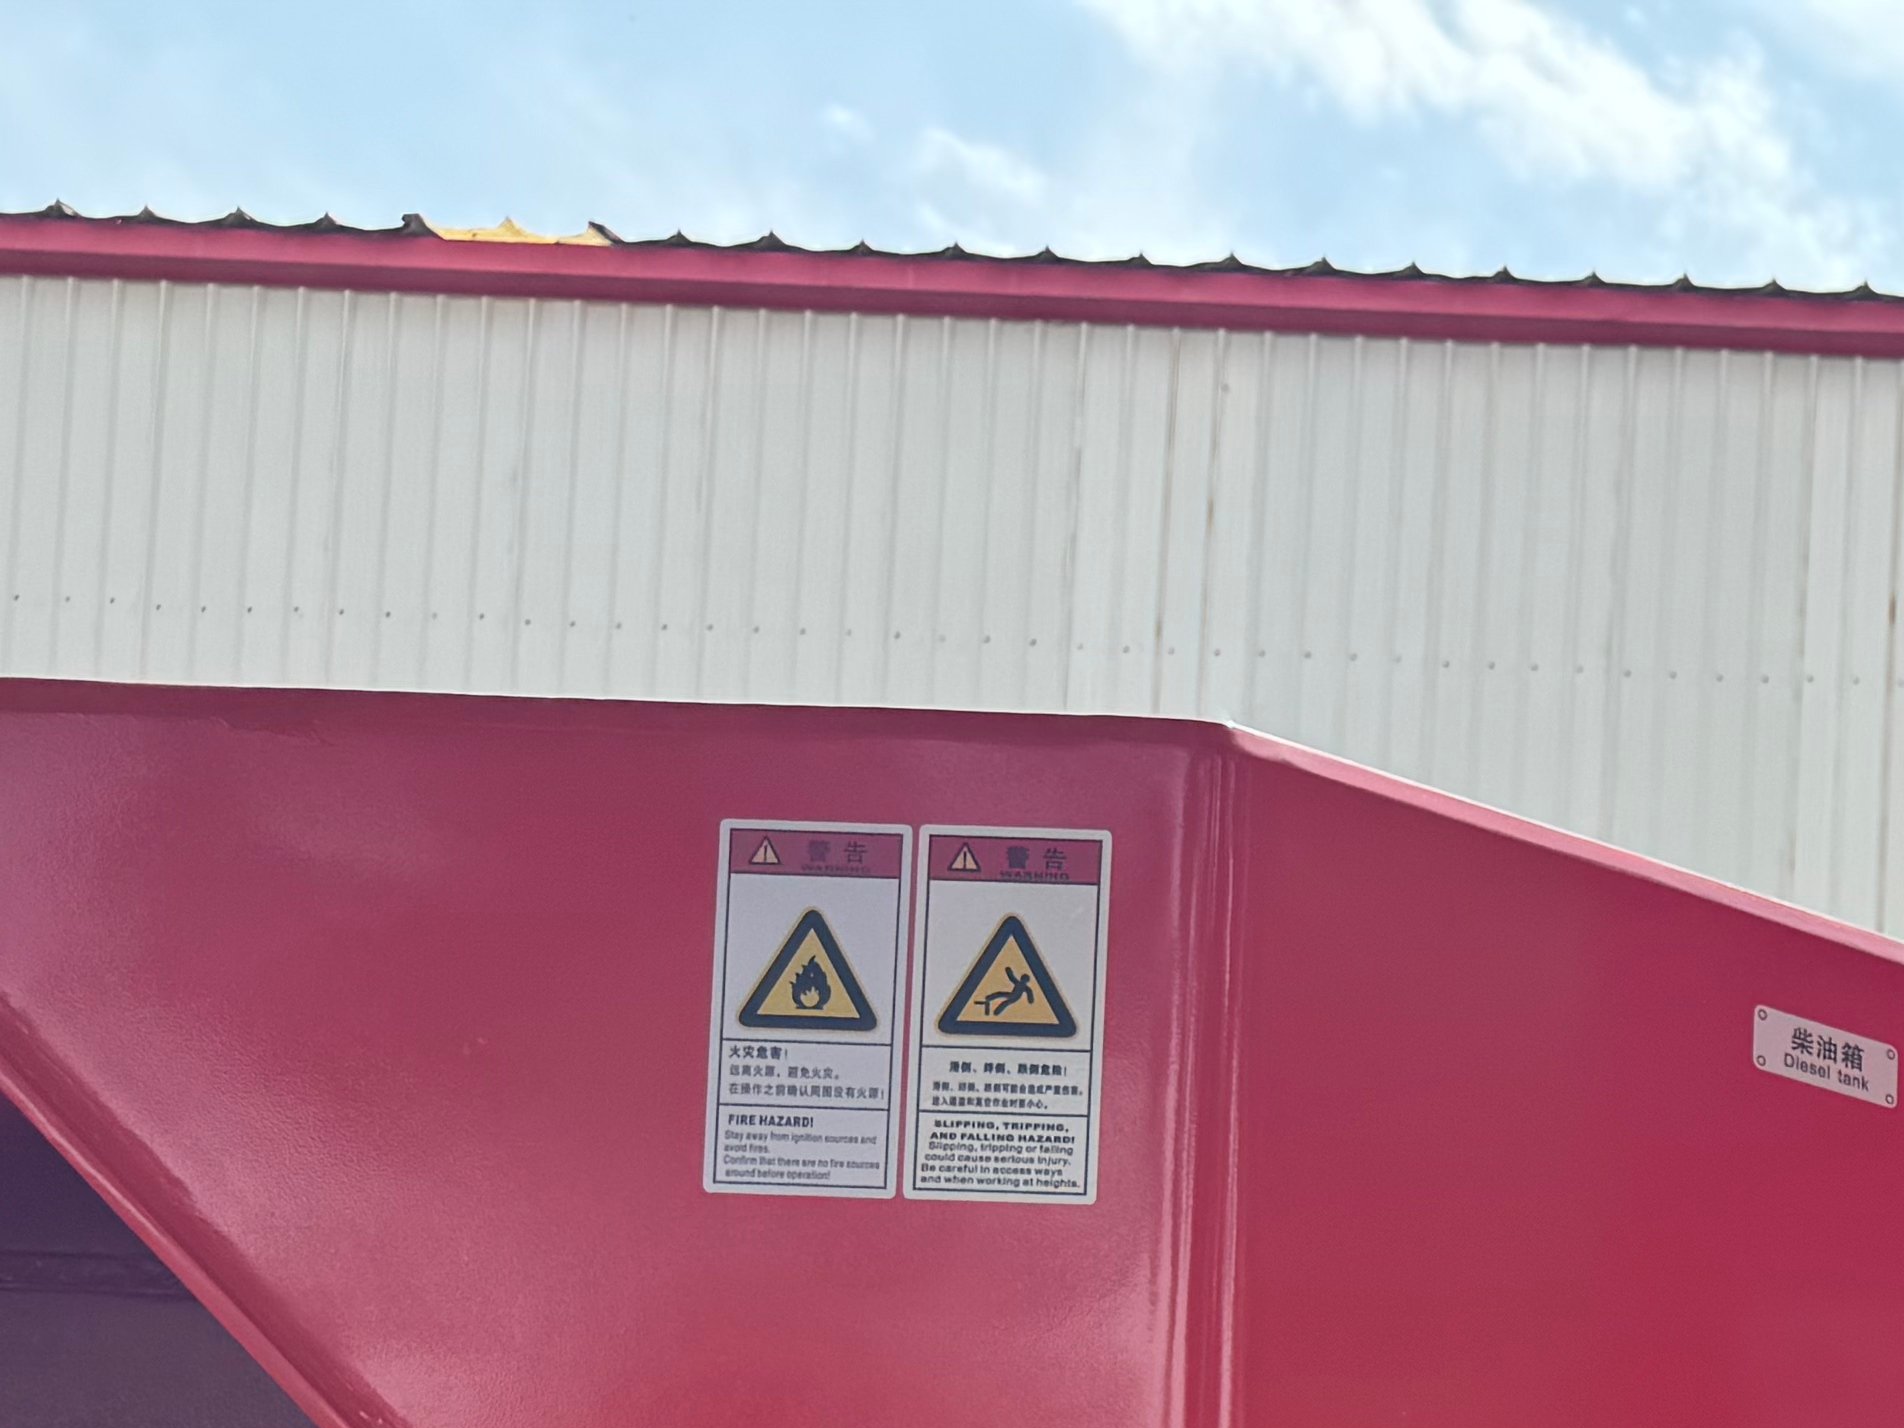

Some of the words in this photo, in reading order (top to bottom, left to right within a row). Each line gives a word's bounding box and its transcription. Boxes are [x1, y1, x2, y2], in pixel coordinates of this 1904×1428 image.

[1791, 1027, 1864, 1072] 柴油箱
[1784, 1052, 1830, 1080] Diesel
[1838, 1069, 1869, 1092] tank
[728, 1114, 756, 1125] FIRE
[759, 1115, 814, 1128] HAZARD!
[934, 1119, 999, 1131] SLIPPING,
[1002, 1122, 1069, 1132] TRIPPING,
[930, 1131, 957, 1140] AND
[960, 1132, 1014, 1142] FALLING
[1018, 1134, 1075, 1144] HAZARD!
[980, 1142, 1023, 1153] tripping
[1025, 1145, 1037, 1153] or
[1039, 1144, 1074, 1156] falling
[924, 1152, 955, 1161] could
[957, 1155, 991, 1163] cause
[993, 1154, 1035, 1164] serious
[921, 1163, 936, 1172] Be
[938, 1163, 978, 1174] careful
[980, 1165, 990, 1174] in
[992, 1167, 1032, 1175] access
[1035, 1168, 1063, 1178] ways
[920, 1175, 941, 1183] and
[944, 1175, 974, 1184] when
[976, 1176, 1020, 1187] working
[1023, 1178, 1034, 1186] at
